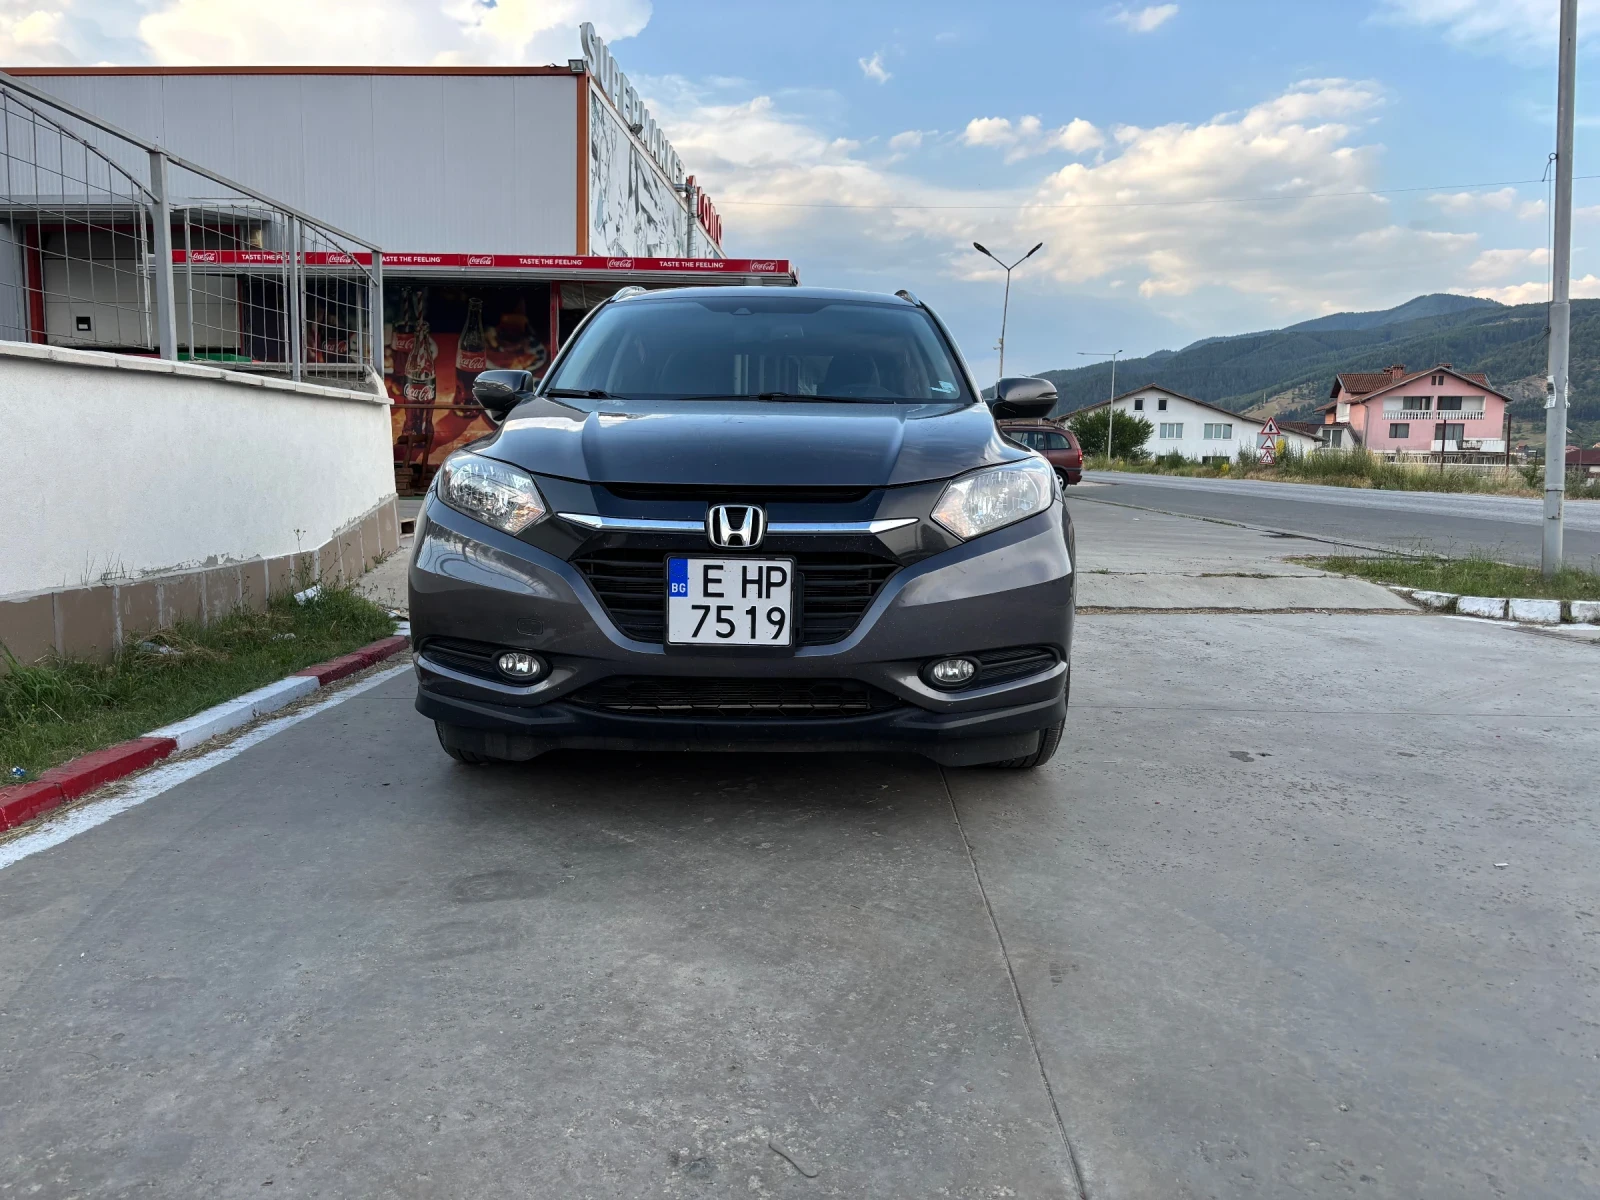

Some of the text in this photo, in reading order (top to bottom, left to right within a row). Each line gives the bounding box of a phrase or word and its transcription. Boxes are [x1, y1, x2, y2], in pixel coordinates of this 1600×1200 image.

[469, 256, 492, 265] Coca-Cola
[555, 258, 583, 266] FEELING
[696, 261, 725, 269] FEELING
[703, 564, 787, 599] E HP
[671, 583, 687, 593] BG
[691, 604, 786, 640] 7519
